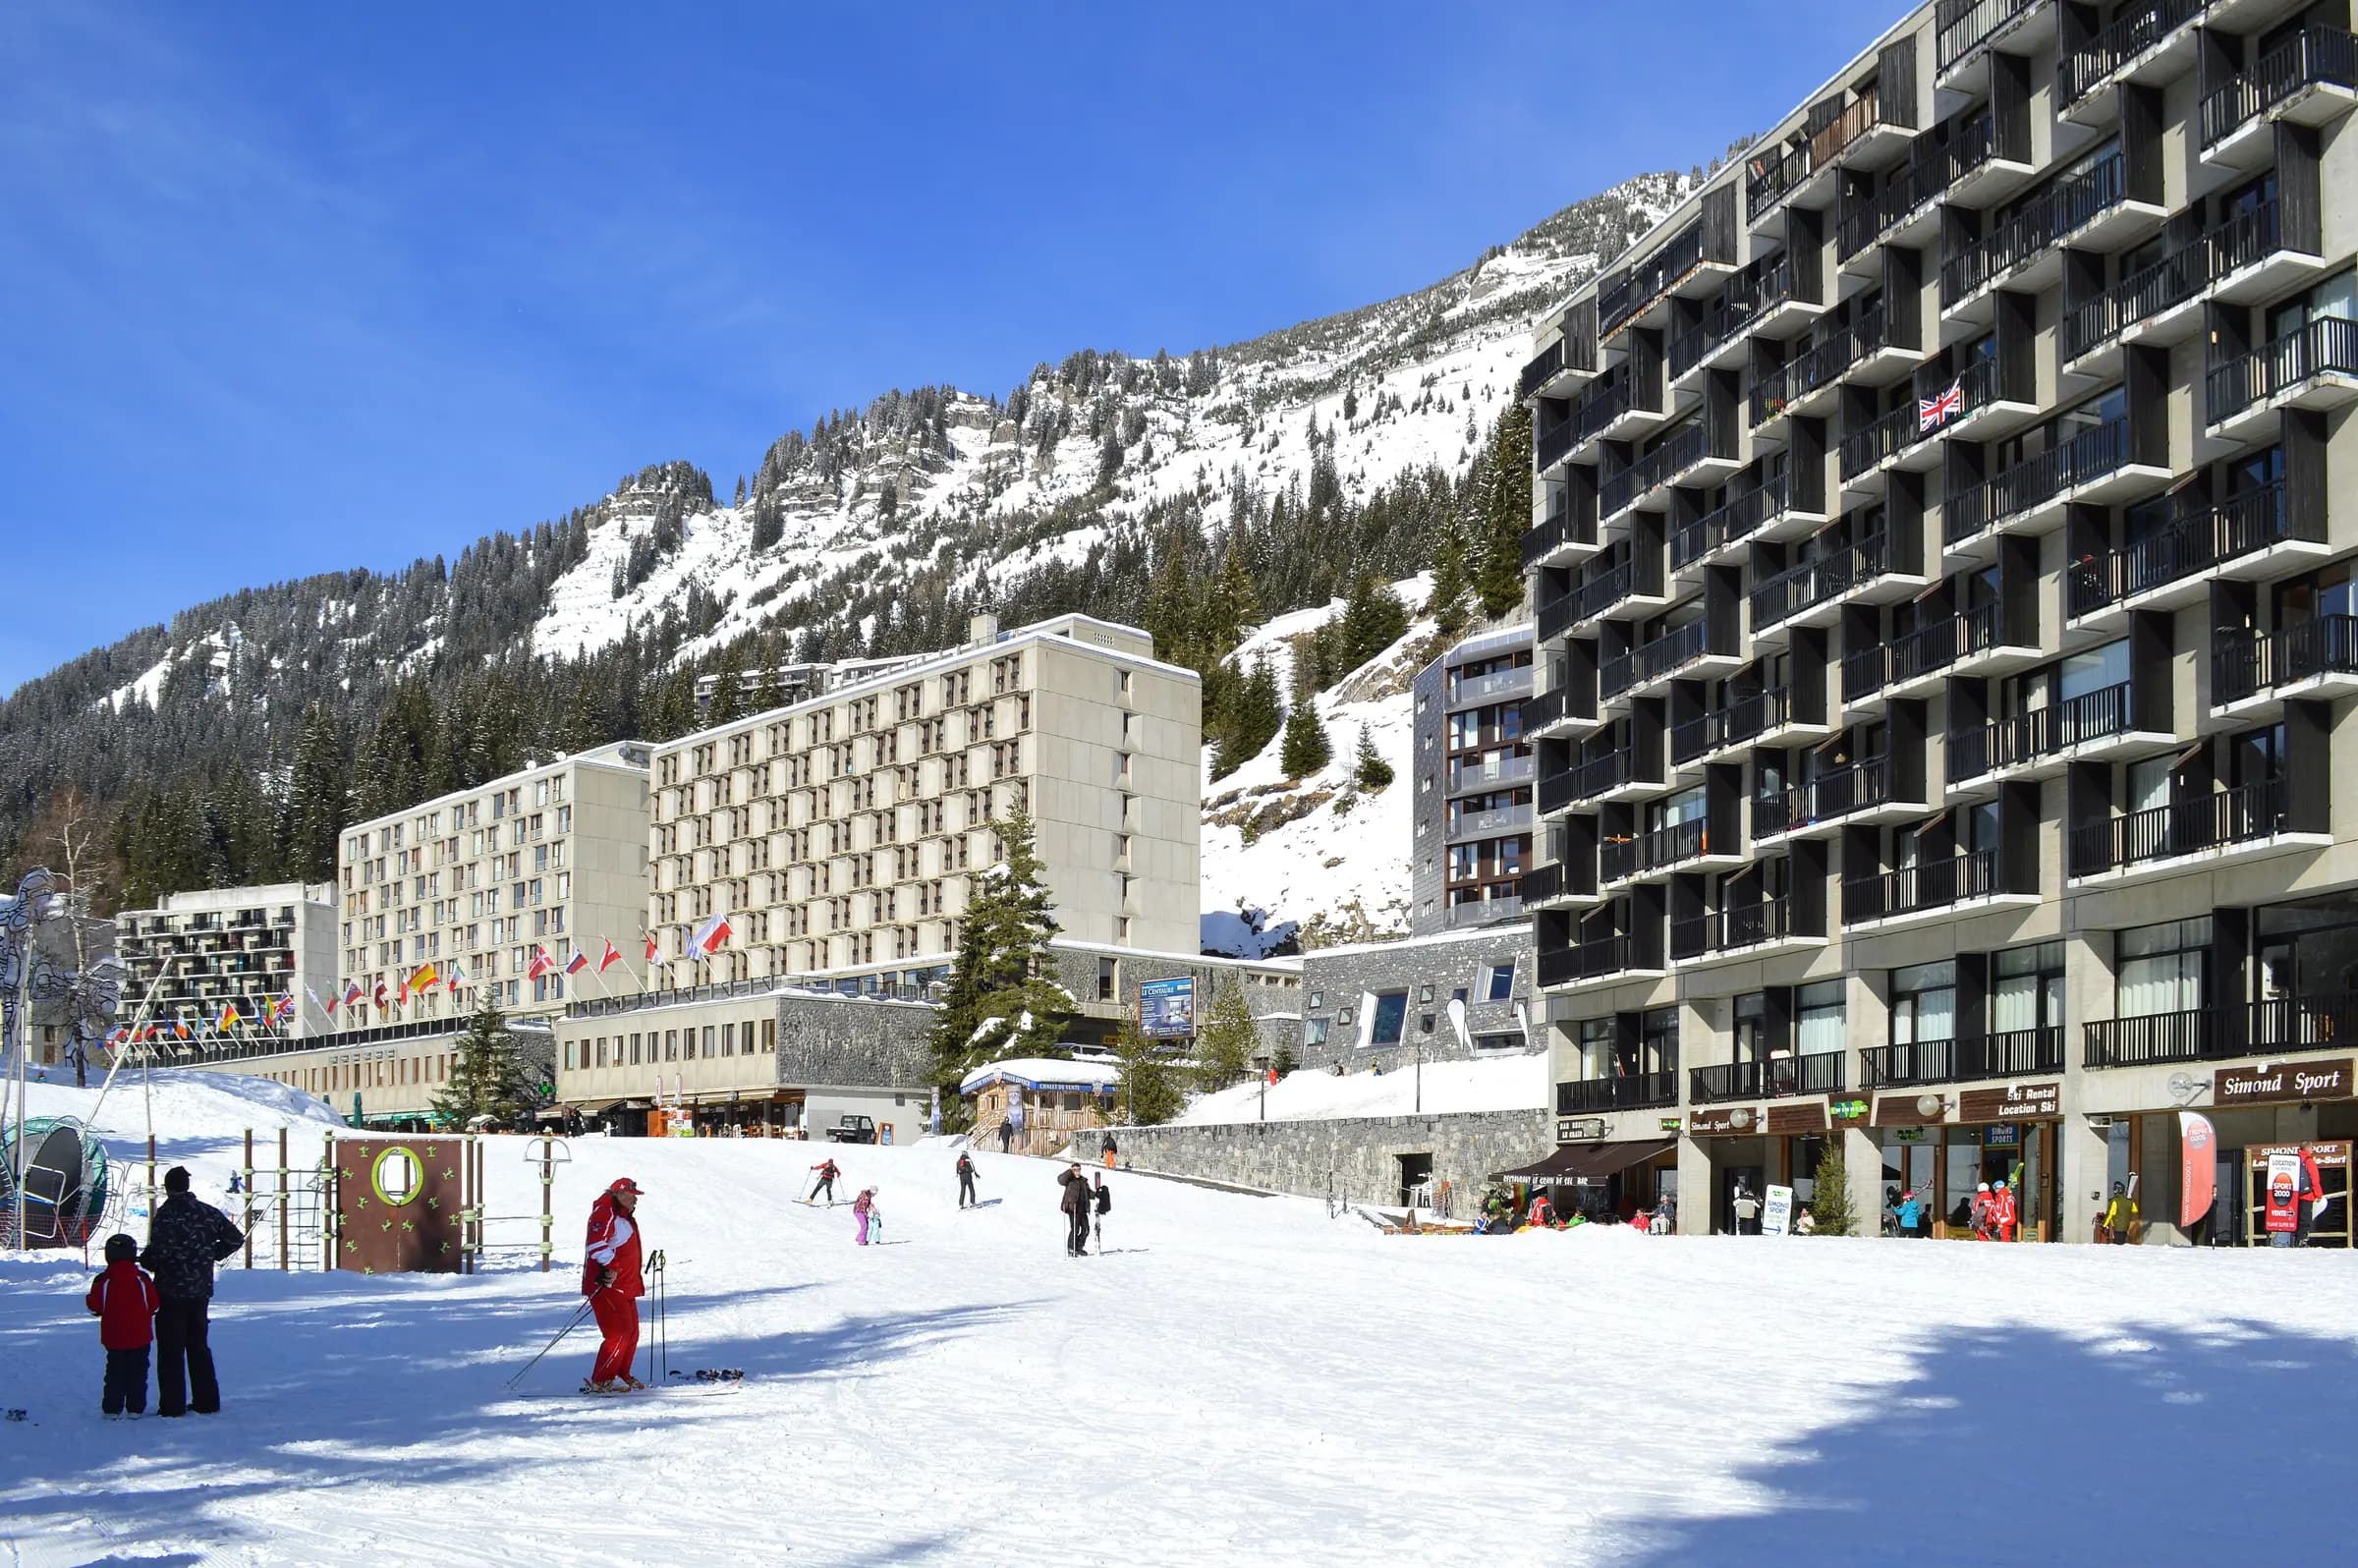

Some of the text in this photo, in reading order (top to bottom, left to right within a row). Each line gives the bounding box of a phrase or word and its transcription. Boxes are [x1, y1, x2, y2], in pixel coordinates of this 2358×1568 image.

[2224, 1071, 2339, 1094] Simond Sport
[2007, 1087, 2056, 1100] Ski Rental
[1998, 1101, 2056, 1115] Location Ski
[1690, 1121, 1712, 1131] Simond
[1714, 1120, 1730, 1132] Sport
[2311, 1145, 2337, 1153] PORT
